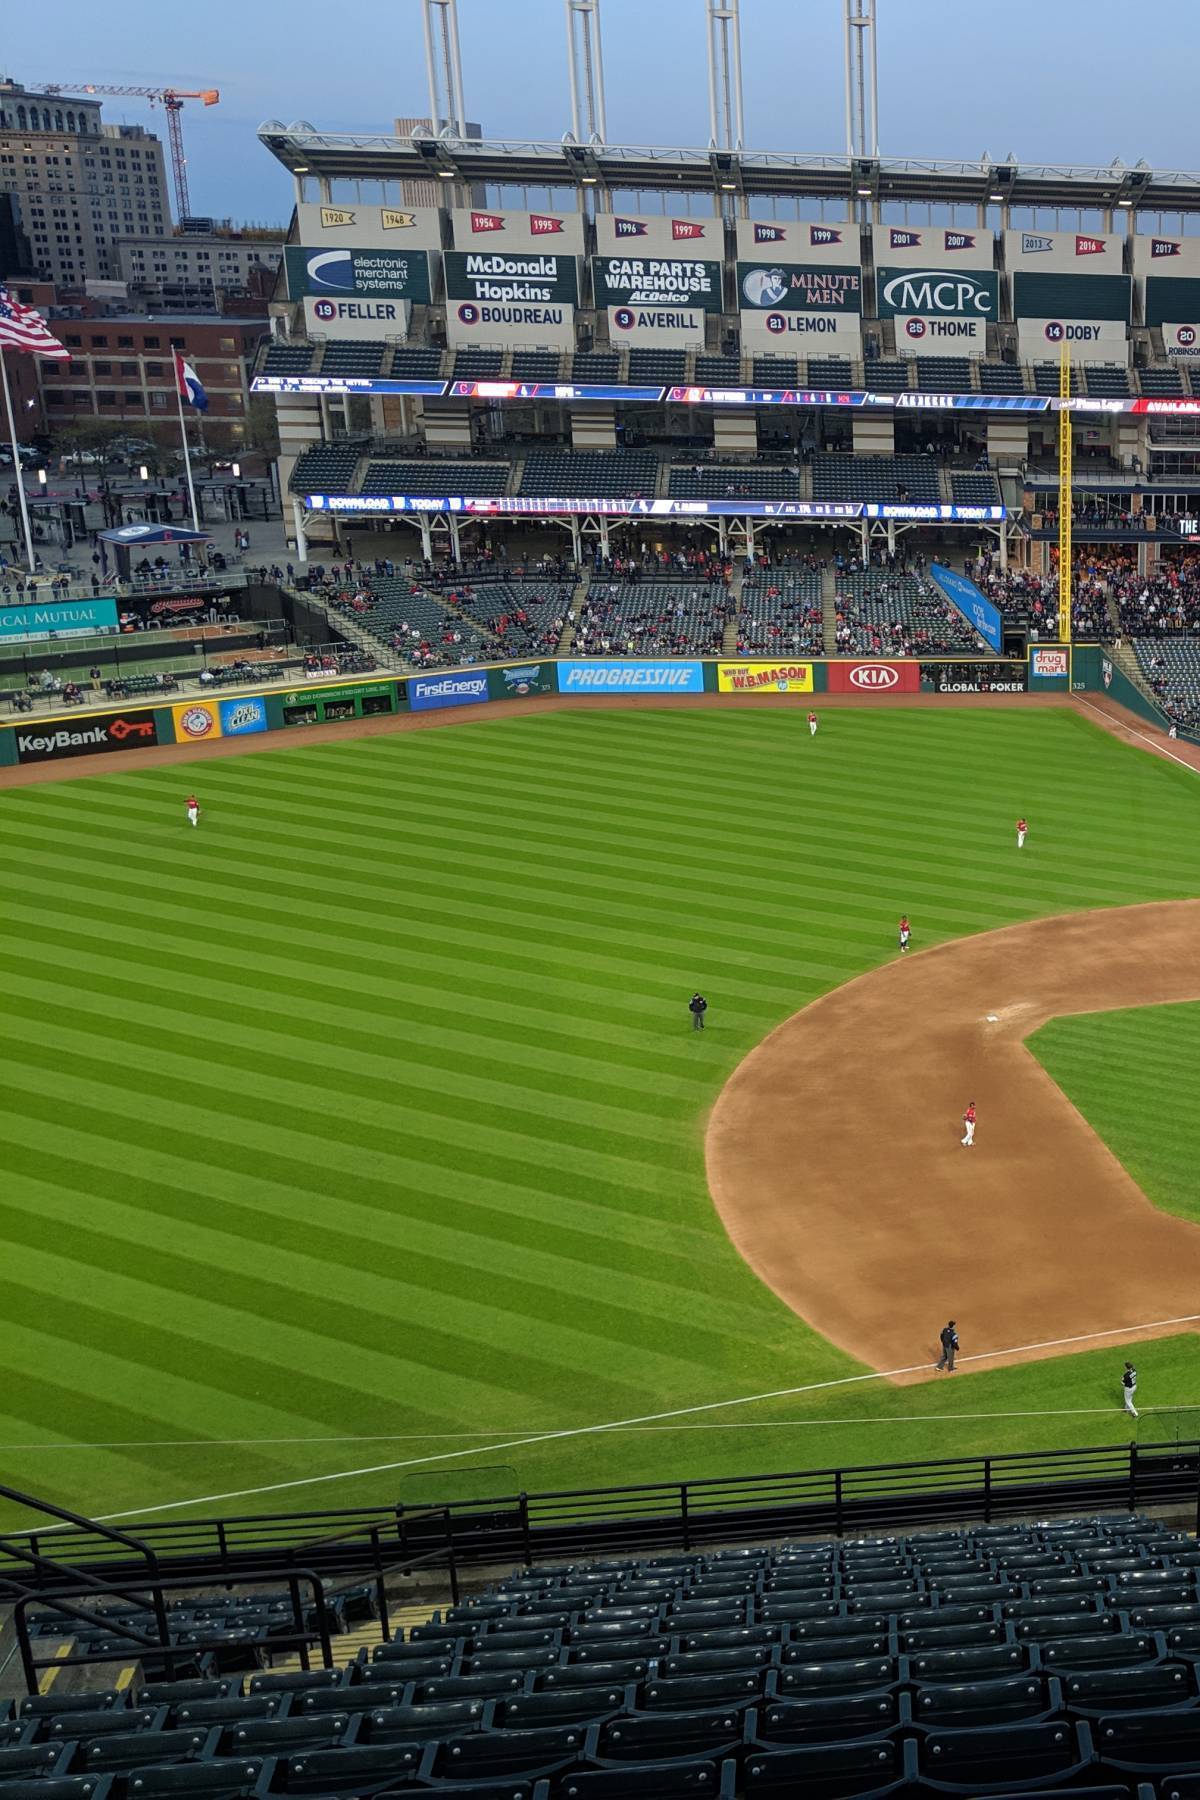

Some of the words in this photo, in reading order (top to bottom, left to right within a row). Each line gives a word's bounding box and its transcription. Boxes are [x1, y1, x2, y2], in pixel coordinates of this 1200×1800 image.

[324, 213, 344, 224] 1920
[385, 213, 404, 225] 1948
[475, 217, 493, 228] 1954
[533, 220, 552, 230] 1995
[618, 223, 637, 234] 1996
[674, 225, 693, 236] 1997
[757, 228, 776, 239] 1998
[813, 230, 832, 241] 1999
[892, 233, 911, 245] 2001
[947, 235, 965, 247] 2007
[1025, 239, 1043, 249] 2013
[1079, 240, 1097, 252] 2016
[1155, 244, 1172, 255] 2017
[354, 256, 408, 269] electronic
[466, 256, 557, 275] McDonald
[608, 260, 645, 275] CAR
[649, 262, 706, 277] PARTS
[355, 267, 407, 280] merchant
[353, 278, 404, 291] systems
[605, 274, 711, 292] WAREHOUSE
[790, 273, 860, 290] MINUTE
[475, 282, 551, 302] Hopkins
[629, 290, 690, 303] ACDelco
[806, 289, 845, 305] MEN
[900, 281, 992, 312] MCPc
[318, 304, 332, 316] 19
[339, 303, 396, 320] FELLER
[464, 308, 473, 320] 5
[481, 307, 562, 325] BOUDREAU
[621, 313, 629, 324] 3
[637, 312, 698, 329] AVERILL
[769, 318, 783, 329] 21
[787, 317, 837, 333] LEMON
[909, 322, 924, 334] 25
[929, 321, 977, 337] THOME
[1047, 326, 1060, 337] 14
[1066, 325, 1100, 340] DOBY
[1179, 331, 1194, 341] 20
[329, 498, 388, 509] DOWNLOAD
[410, 499, 444, 510] TODAY
[883, 505, 937, 517] DOWNLOAD
[956, 507, 986, 518] TODAY
[1180, 520, 1198, 534] THE
[34, 609, 96, 625] MUTUAL
[1036, 650, 1061, 664] drug
[1038, 664, 1067, 673] mart
[568, 668, 692, 685] PROGRESSIVE
[858, 669, 891, 684] KIA
[416, 679, 488, 697] FirstEnergy
[940, 683, 980, 692] GLOBAL
[990, 682, 1024, 691] POKER
[1073, 682, 1086, 690] 325
[232, 710, 260, 727] CLEAN
[18, 727, 108, 753] KeyBank
